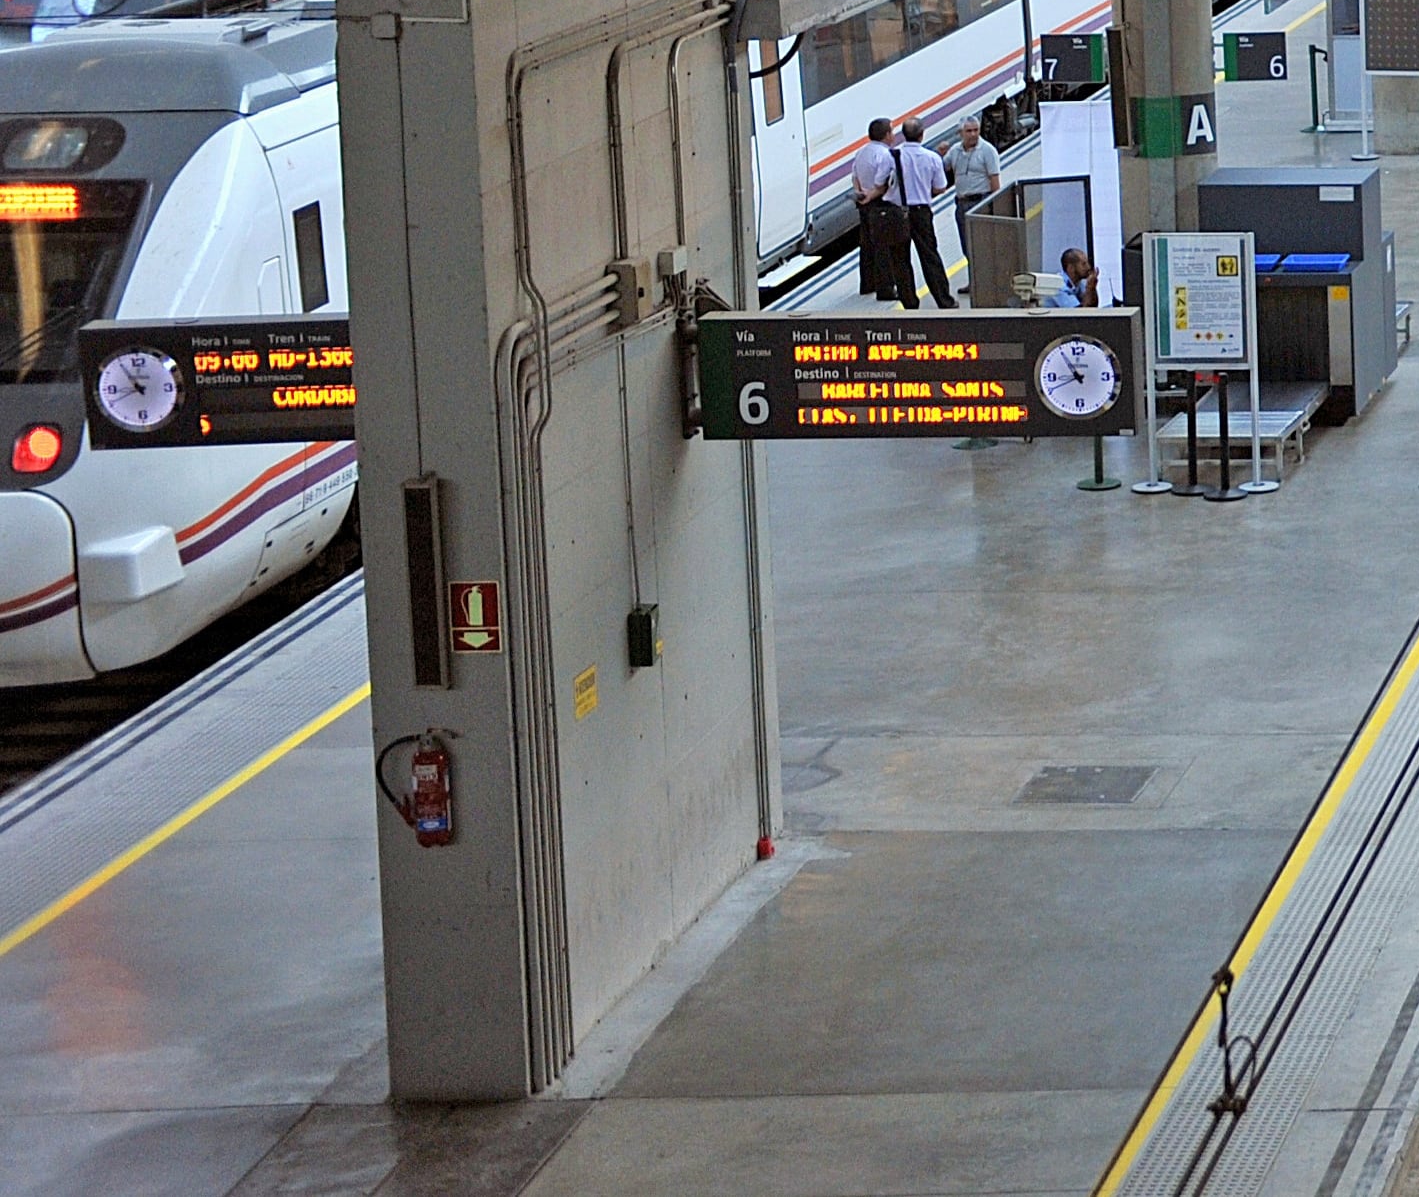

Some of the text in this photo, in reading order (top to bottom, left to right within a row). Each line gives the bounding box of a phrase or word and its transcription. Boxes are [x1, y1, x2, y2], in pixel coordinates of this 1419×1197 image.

[1044, 58, 1058, 81] 7
[1270, 55, 1285, 78] 6
[1186, 104, 1214, 145] A
[191, 336, 221, 347] Hora
[267, 333, 295, 345] Tren
[736, 330, 755, 342] Vía
[792, 330, 820, 342] Hora
[865, 330, 891, 341] Tren
[1071, 346, 1085, 356] 12
[195, 373, 247, 384] Destino
[794, 368, 840, 379] Destino
[1047, 372, 1057, 382] 9
[1100, 372, 1110, 382] 3
[738, 381, 770, 425] 6
[1075, 398, 1085, 408] 6
